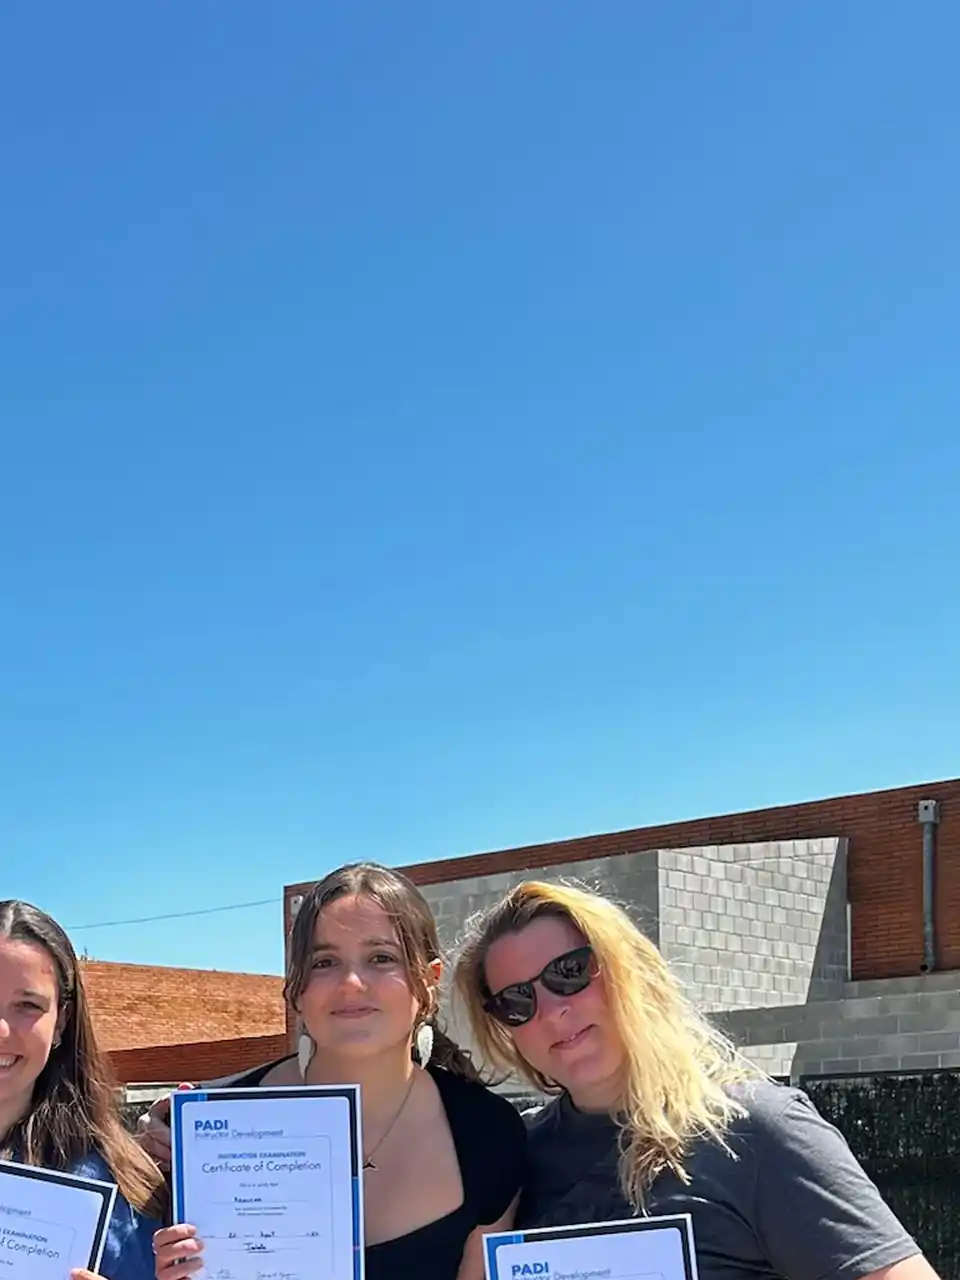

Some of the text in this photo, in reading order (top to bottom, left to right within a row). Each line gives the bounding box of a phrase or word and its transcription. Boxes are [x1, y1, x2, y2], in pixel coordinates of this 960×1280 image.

[194, 1119, 228, 1131] PADI
[232, 1127, 283, 1139] Development
[201, 1160, 321, 1174] Certificate of Completion
[6, 1239, 60, 1259] Completion
[511, 1261, 549, 1276] PADI
[553, 1268, 611, 1280] Development
